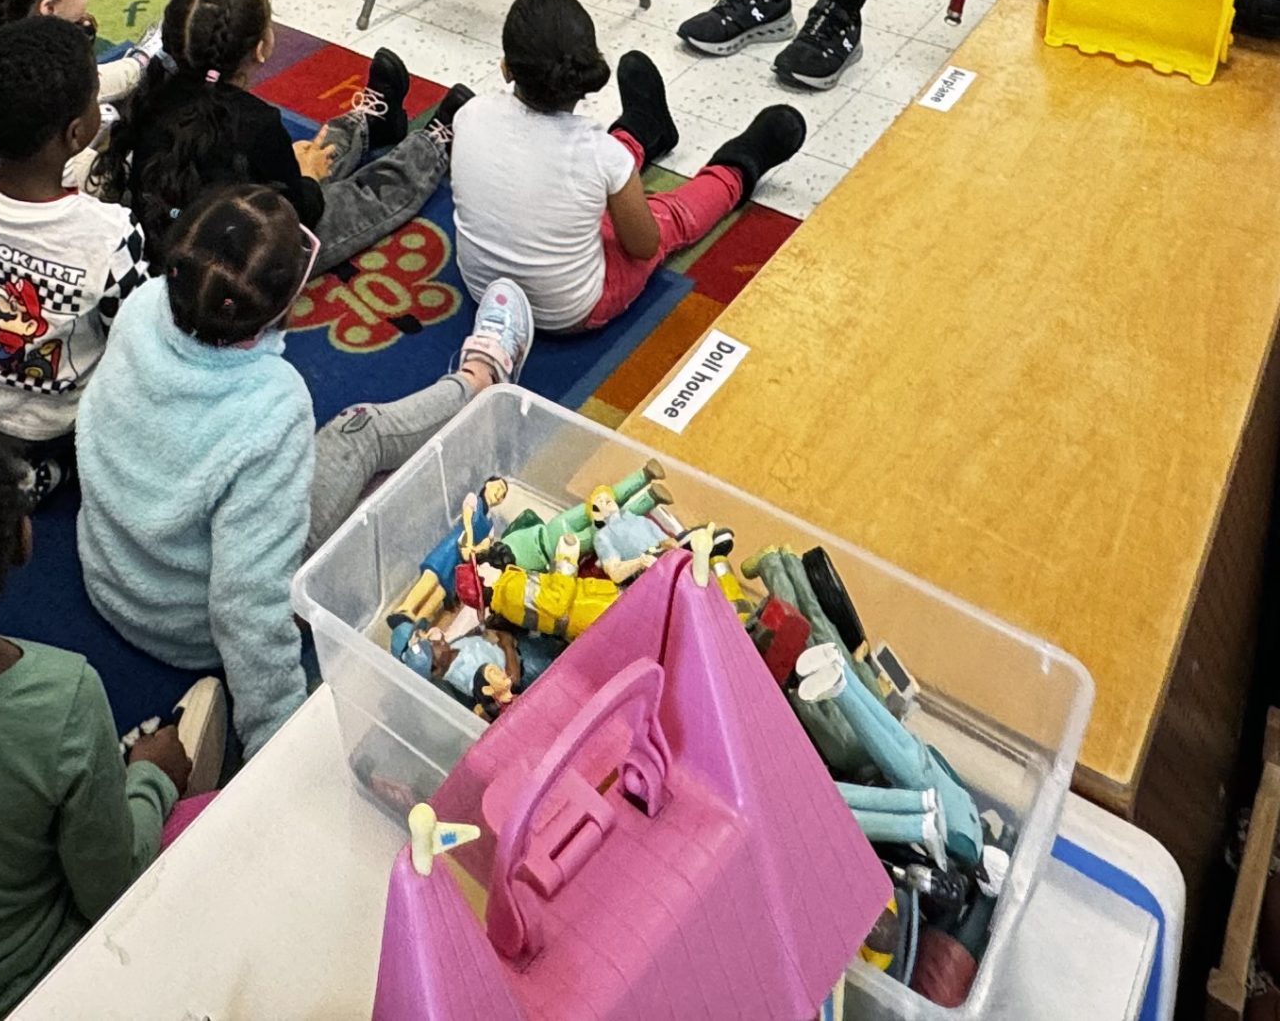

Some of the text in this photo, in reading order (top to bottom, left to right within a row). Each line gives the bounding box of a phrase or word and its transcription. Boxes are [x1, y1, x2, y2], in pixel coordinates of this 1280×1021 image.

[123, 0, 150, 28] f
[930, 69, 966, 103] Airplane
[325, 273, 413, 325] 10
[663, 340, 736, 419] Doll house
